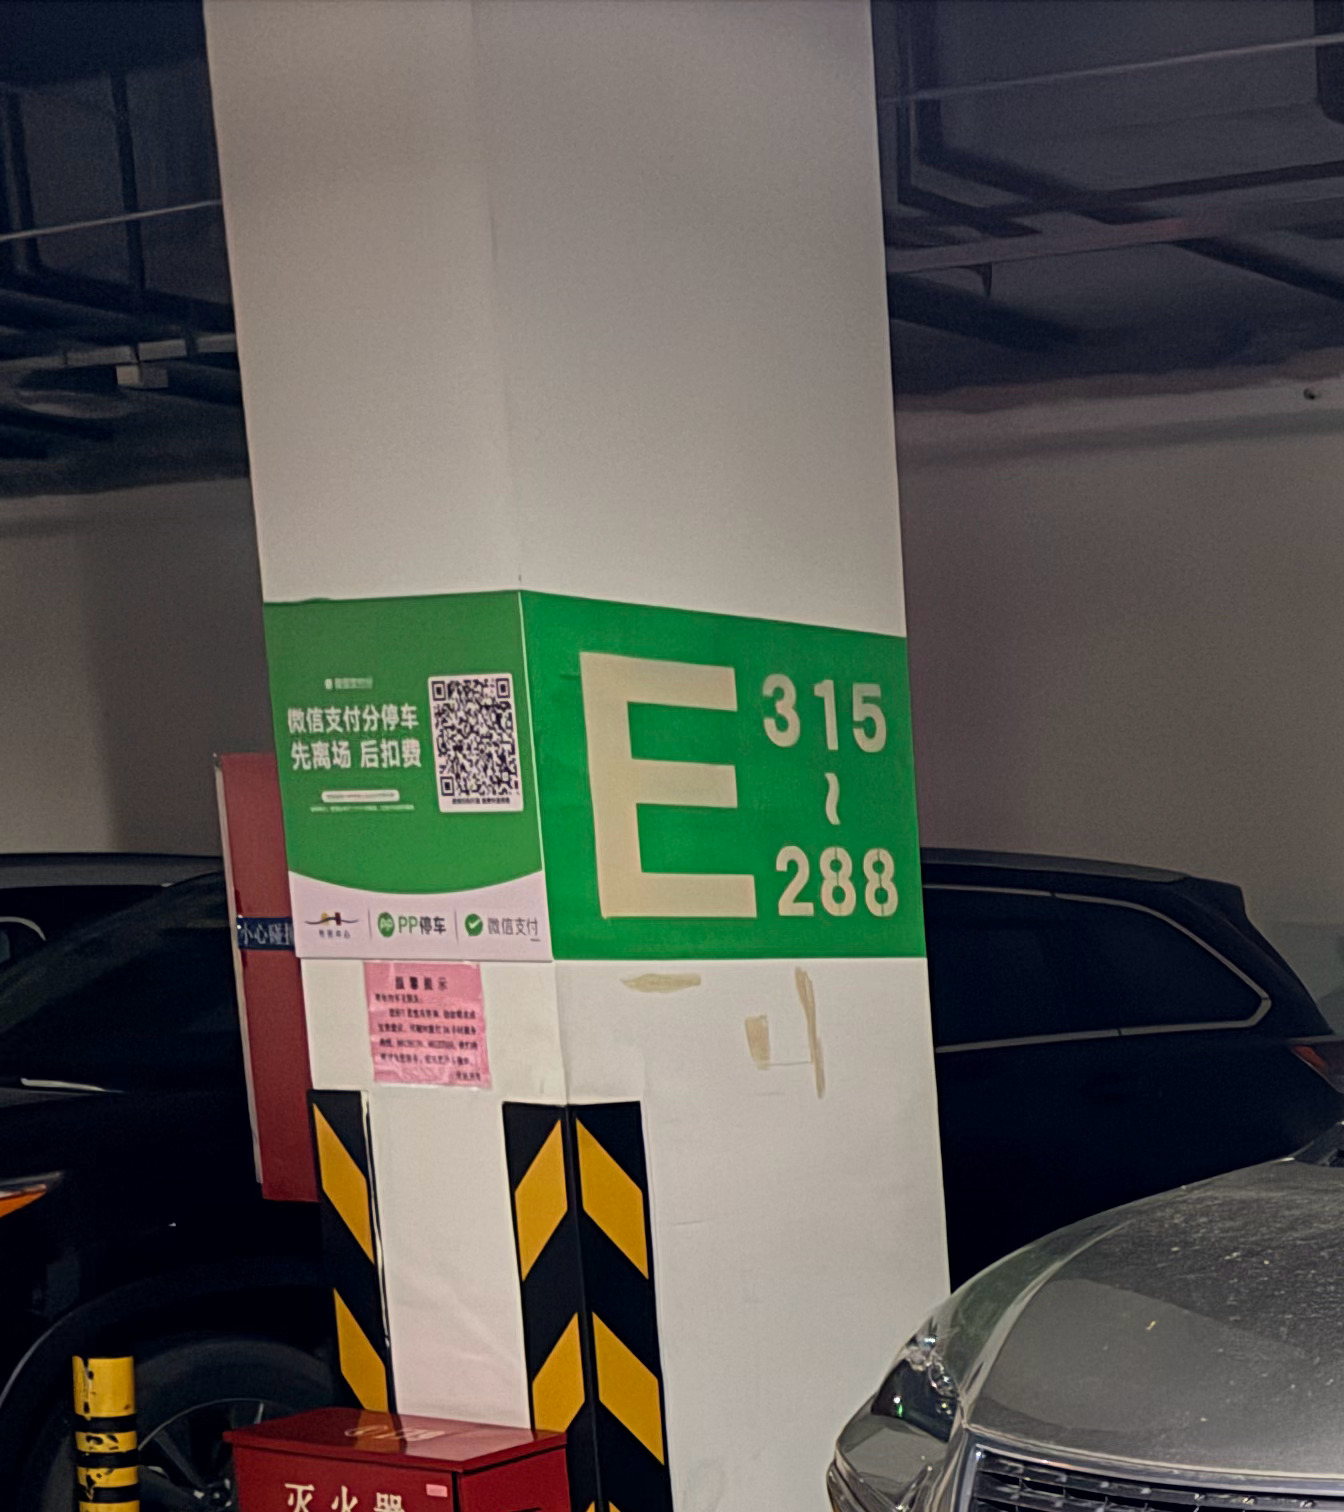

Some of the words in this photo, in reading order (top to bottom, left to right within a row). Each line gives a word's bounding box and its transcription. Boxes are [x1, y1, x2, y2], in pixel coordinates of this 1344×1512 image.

[287, 703, 420, 734] 微信支付分停车
[762, 673, 887, 753] 315
[291, 740, 352, 771] 先离场
[360, 738, 422, 769] 后扣费
[579, 652, 757, 919] E
[775, 845, 899, 917] 288
[398, 916, 447, 935] PP停车
[487, 917, 539, 936] 微信支付
